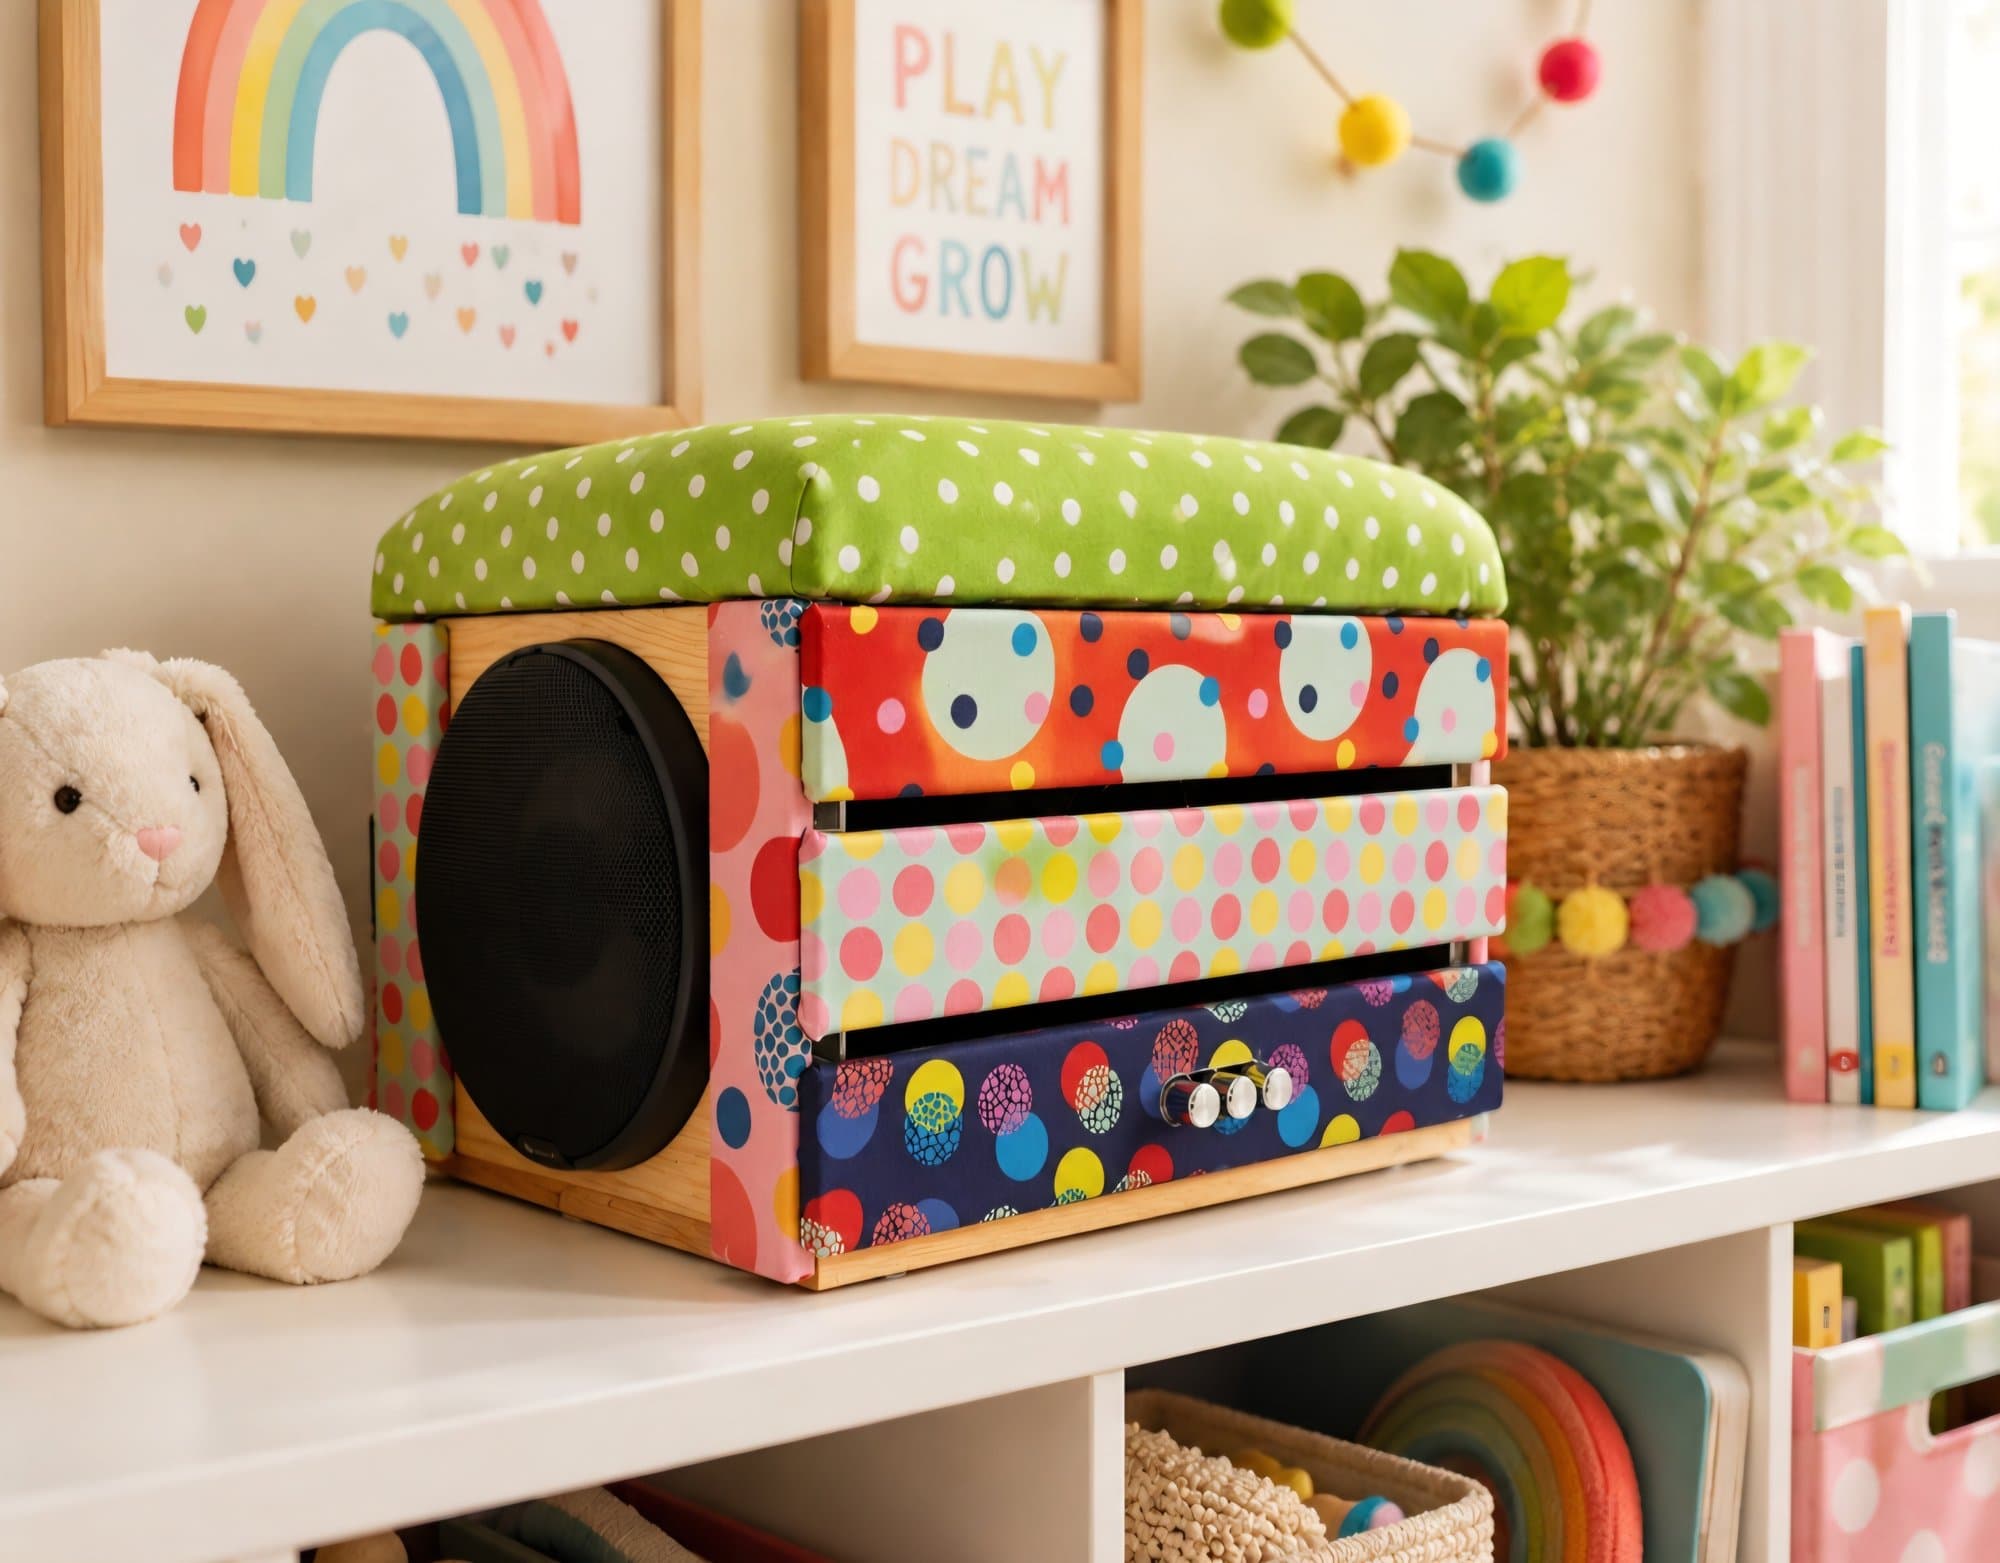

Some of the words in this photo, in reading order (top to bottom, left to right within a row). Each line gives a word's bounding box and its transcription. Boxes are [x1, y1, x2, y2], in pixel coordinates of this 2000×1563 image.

[893, 23, 1067, 130] PLAY
[889, 138, 1071, 226] DREAM
[890, 233, 1069, 325] GROW
